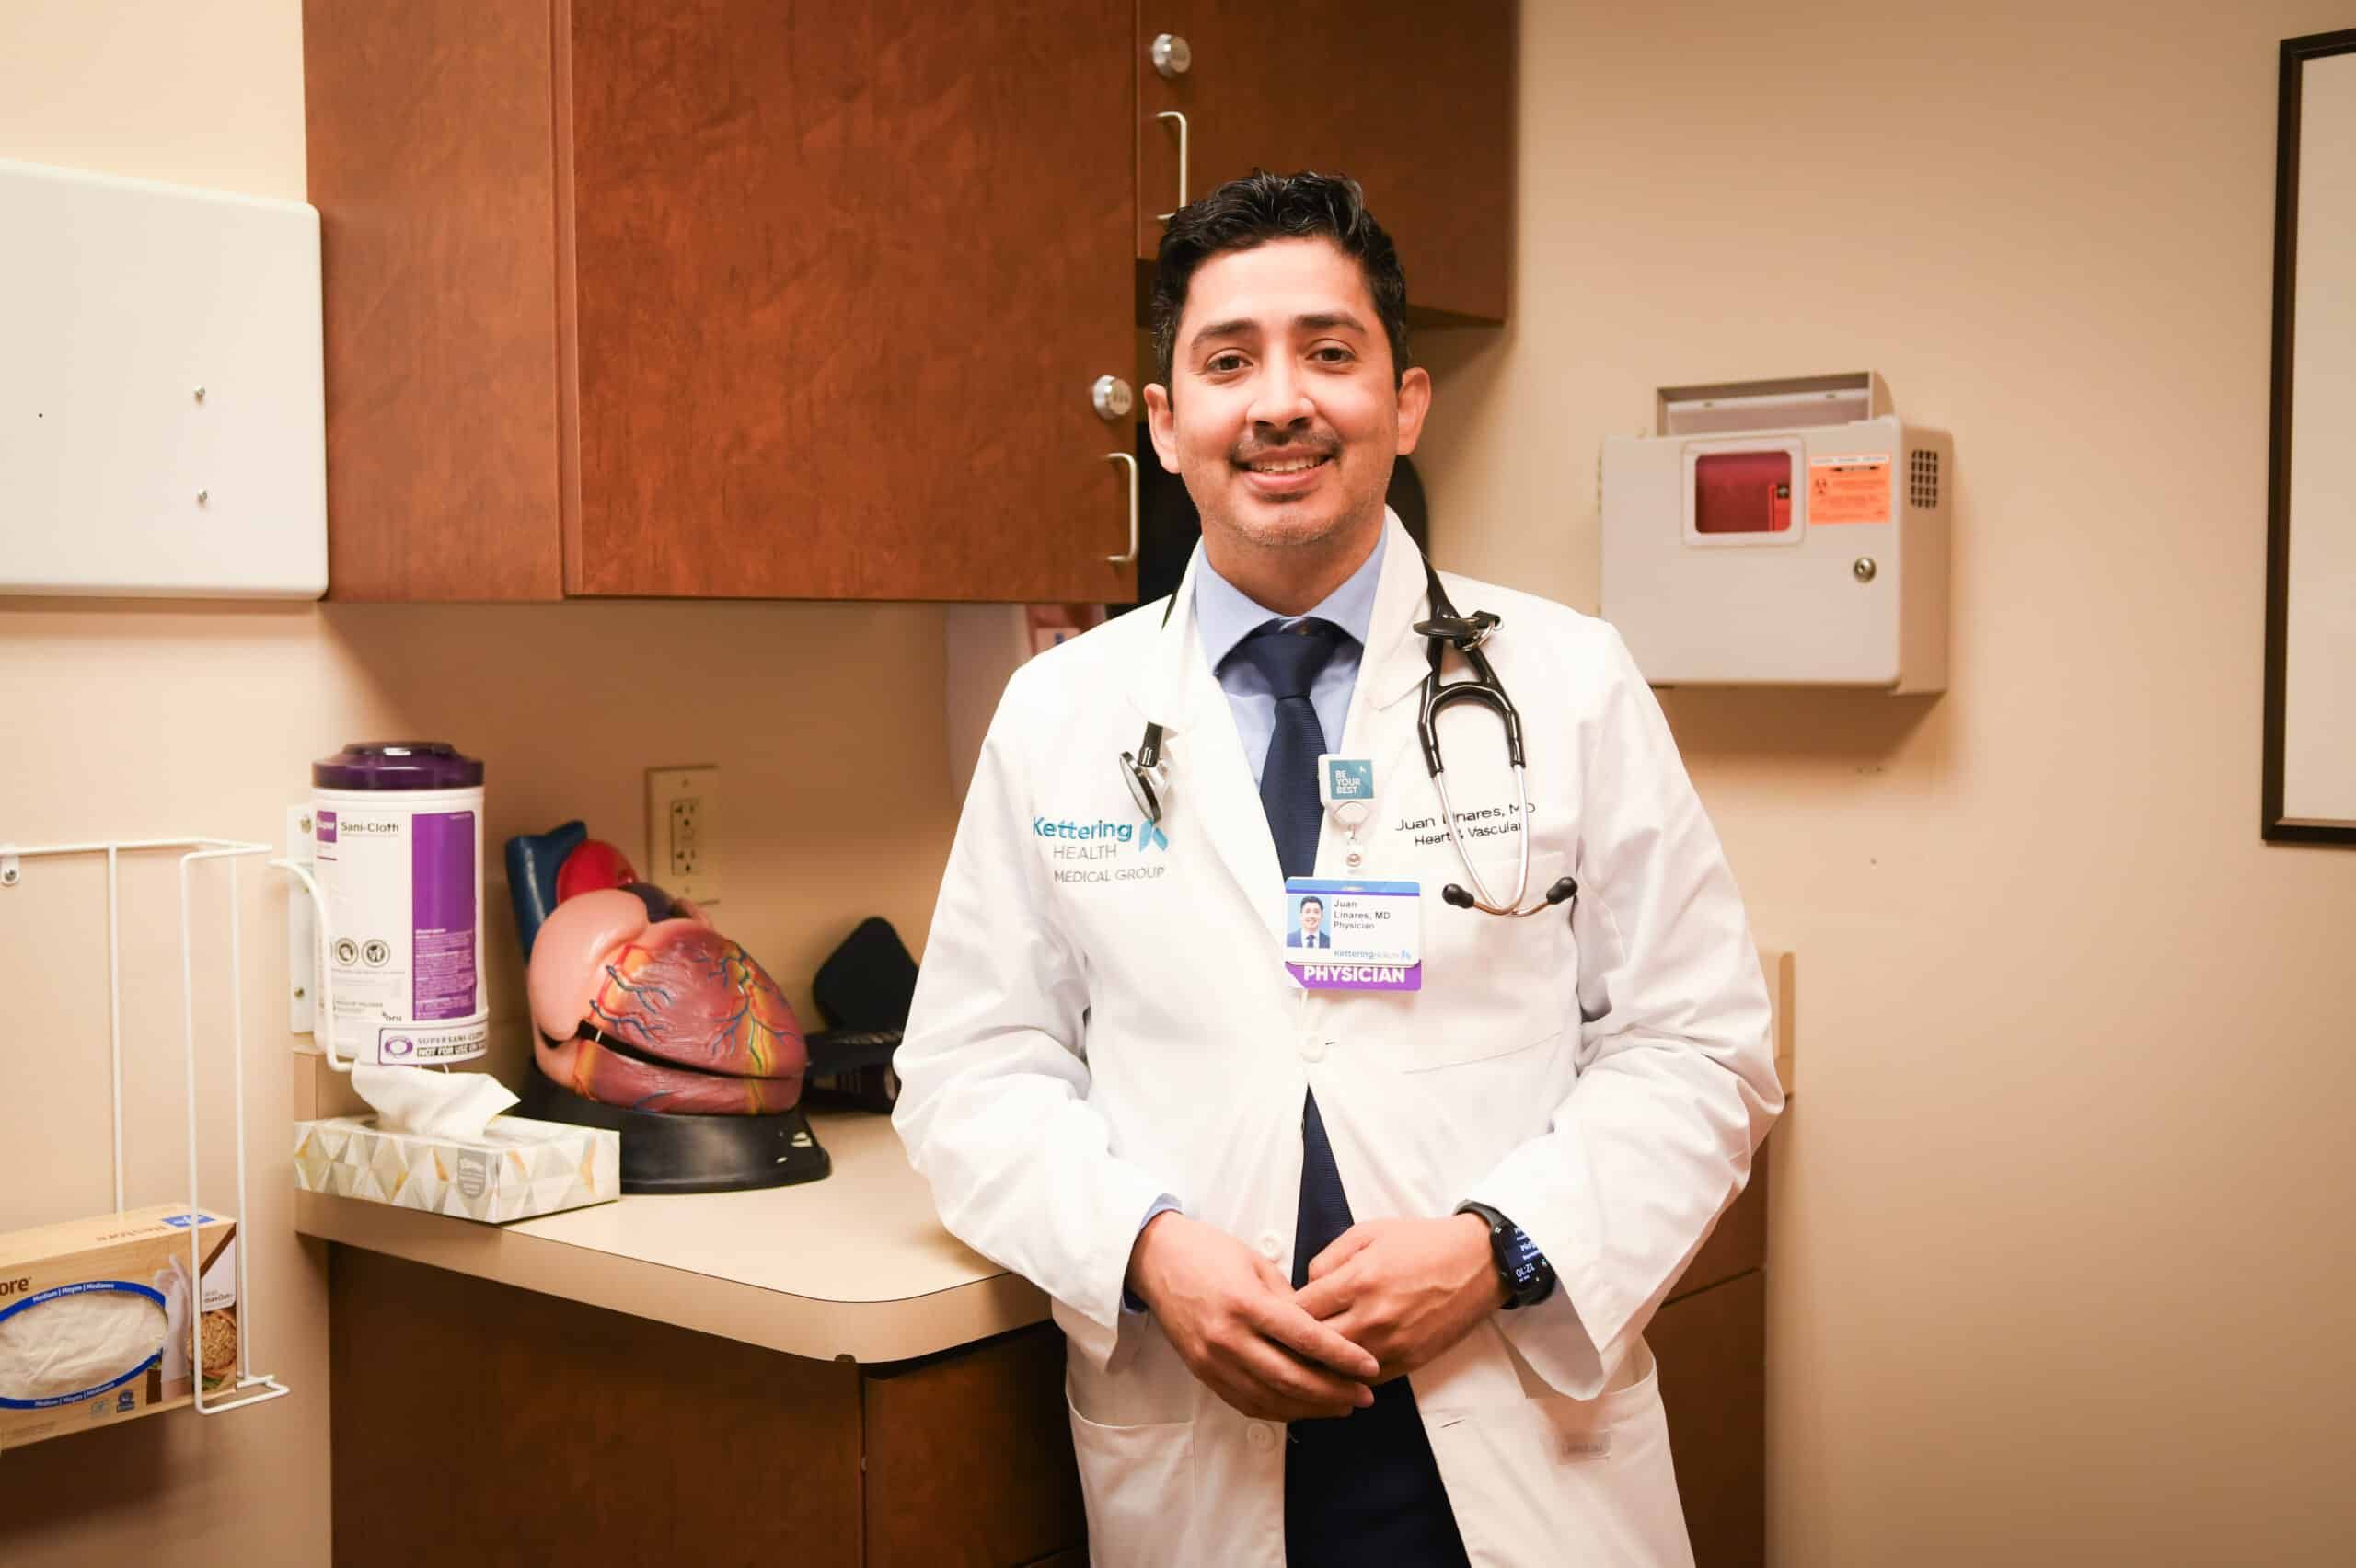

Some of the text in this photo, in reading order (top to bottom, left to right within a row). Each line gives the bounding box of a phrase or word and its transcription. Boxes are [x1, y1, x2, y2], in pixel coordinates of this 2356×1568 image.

[1335, 770, 1347, 779] BE
[1336, 777, 1360, 787] YOUR
[1337, 786, 1357, 794] BEST
[340, 822, 399, 833] Sani-Cloth
[1033, 816, 1133, 842] Kettering
[1395, 818, 1436, 831] Juan
[1415, 832, 1451, 846] Heart
[1053, 844, 1117, 859] HEALTH
[1054, 867, 1165, 882] MEDICAL GROUP
[1334, 898, 1357, 908] Juan
[1334, 910, 1392, 920] Linares, MD
[1334, 920, 1375, 930] Physician
[1334, 950, 1375, 960] Kettering
[1303, 965, 1406, 983] PHYSICIAN
[418, 1048, 434, 1056] NOT
